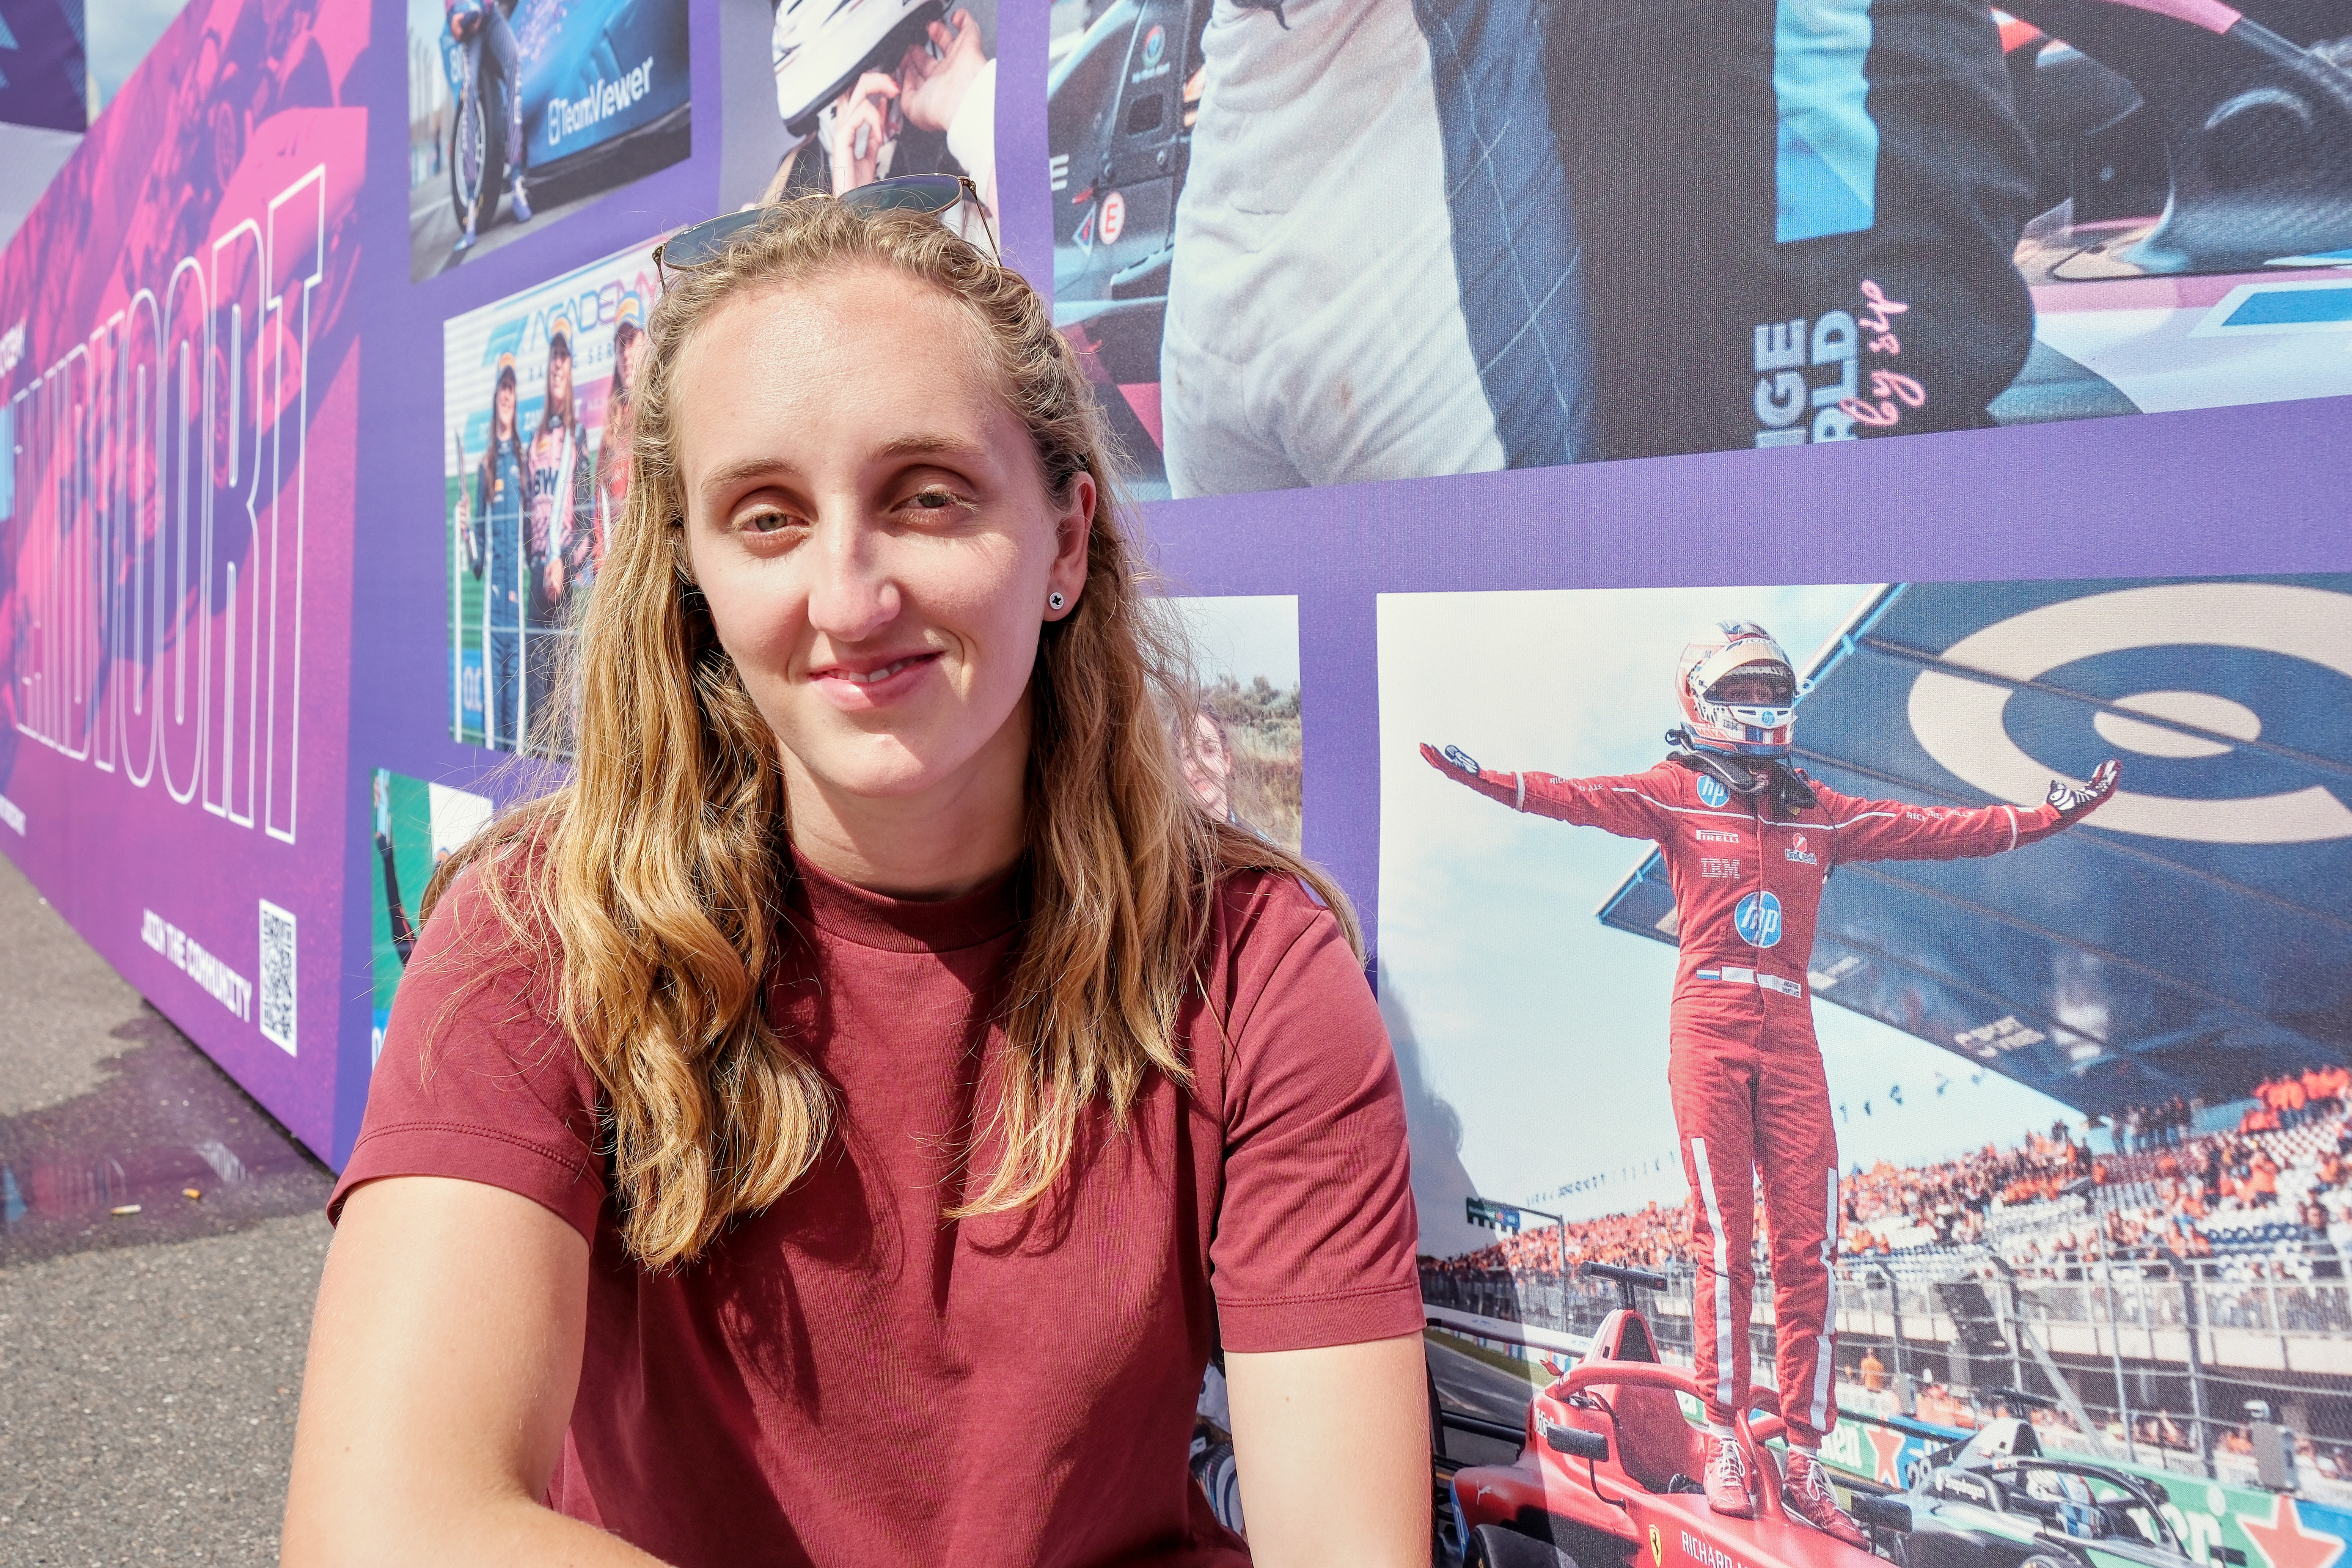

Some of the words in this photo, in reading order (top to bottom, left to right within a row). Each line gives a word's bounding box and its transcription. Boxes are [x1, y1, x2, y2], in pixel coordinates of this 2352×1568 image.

[562, 55, 654, 136] TeamViewer
[1702, 776, 1725, 806] hp
[1695, 829, 1739, 843] PIRELLI
[1701, 858, 1740, 879] IBM
[1741, 892, 1779, 946] hp
[166, 921, 186, 971] THE
[186, 938, 252, 1023] COMMUNITY
